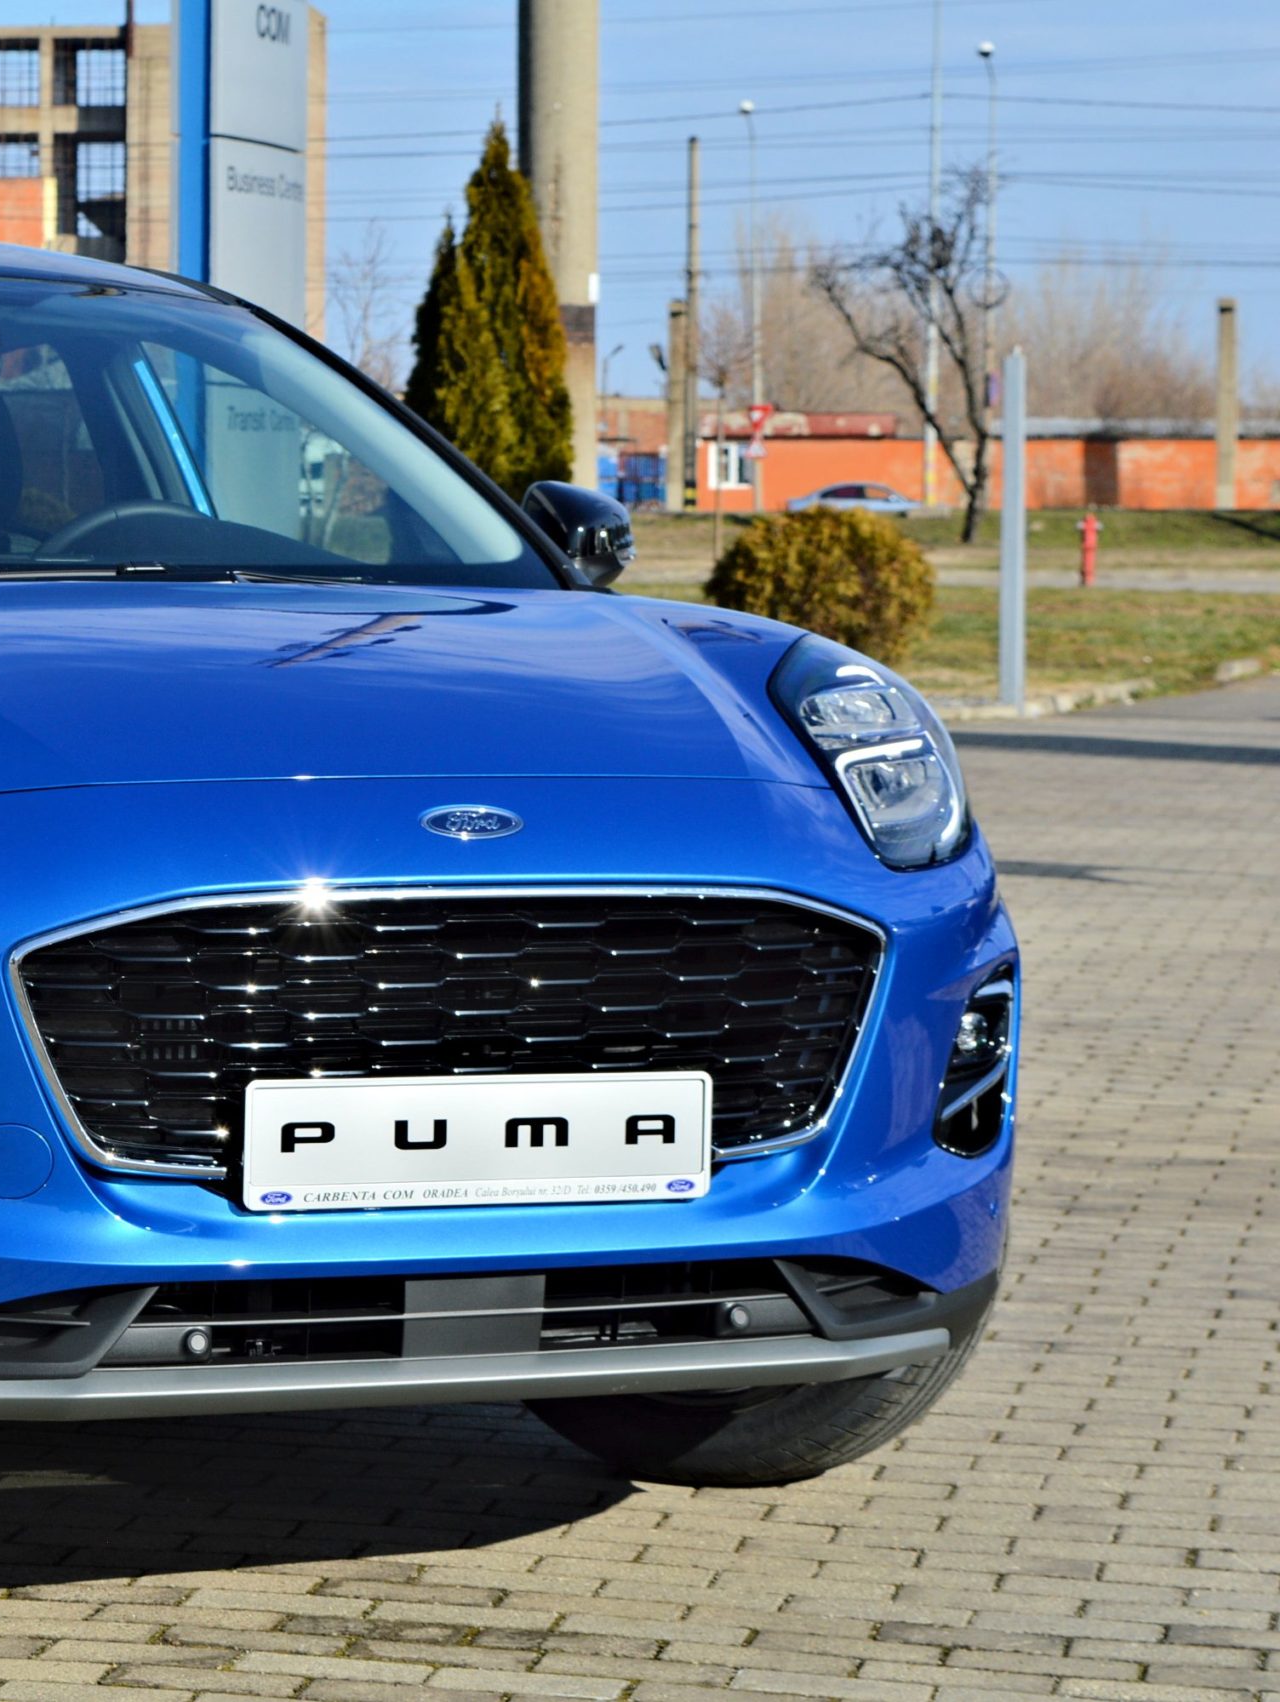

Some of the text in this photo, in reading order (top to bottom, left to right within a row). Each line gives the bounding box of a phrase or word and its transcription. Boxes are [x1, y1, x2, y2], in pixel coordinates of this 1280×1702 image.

[256, 5, 290, 44] COM
[226, 165, 276, 198] Business
[445, 811, 500, 832] Ford
[280, 1113, 676, 1153] PUMA
[303, 1190, 377, 1203] CARBENTA
[383, 1189, 414, 1201] COM
[422, 1187, 469, 1199] ORADEA
